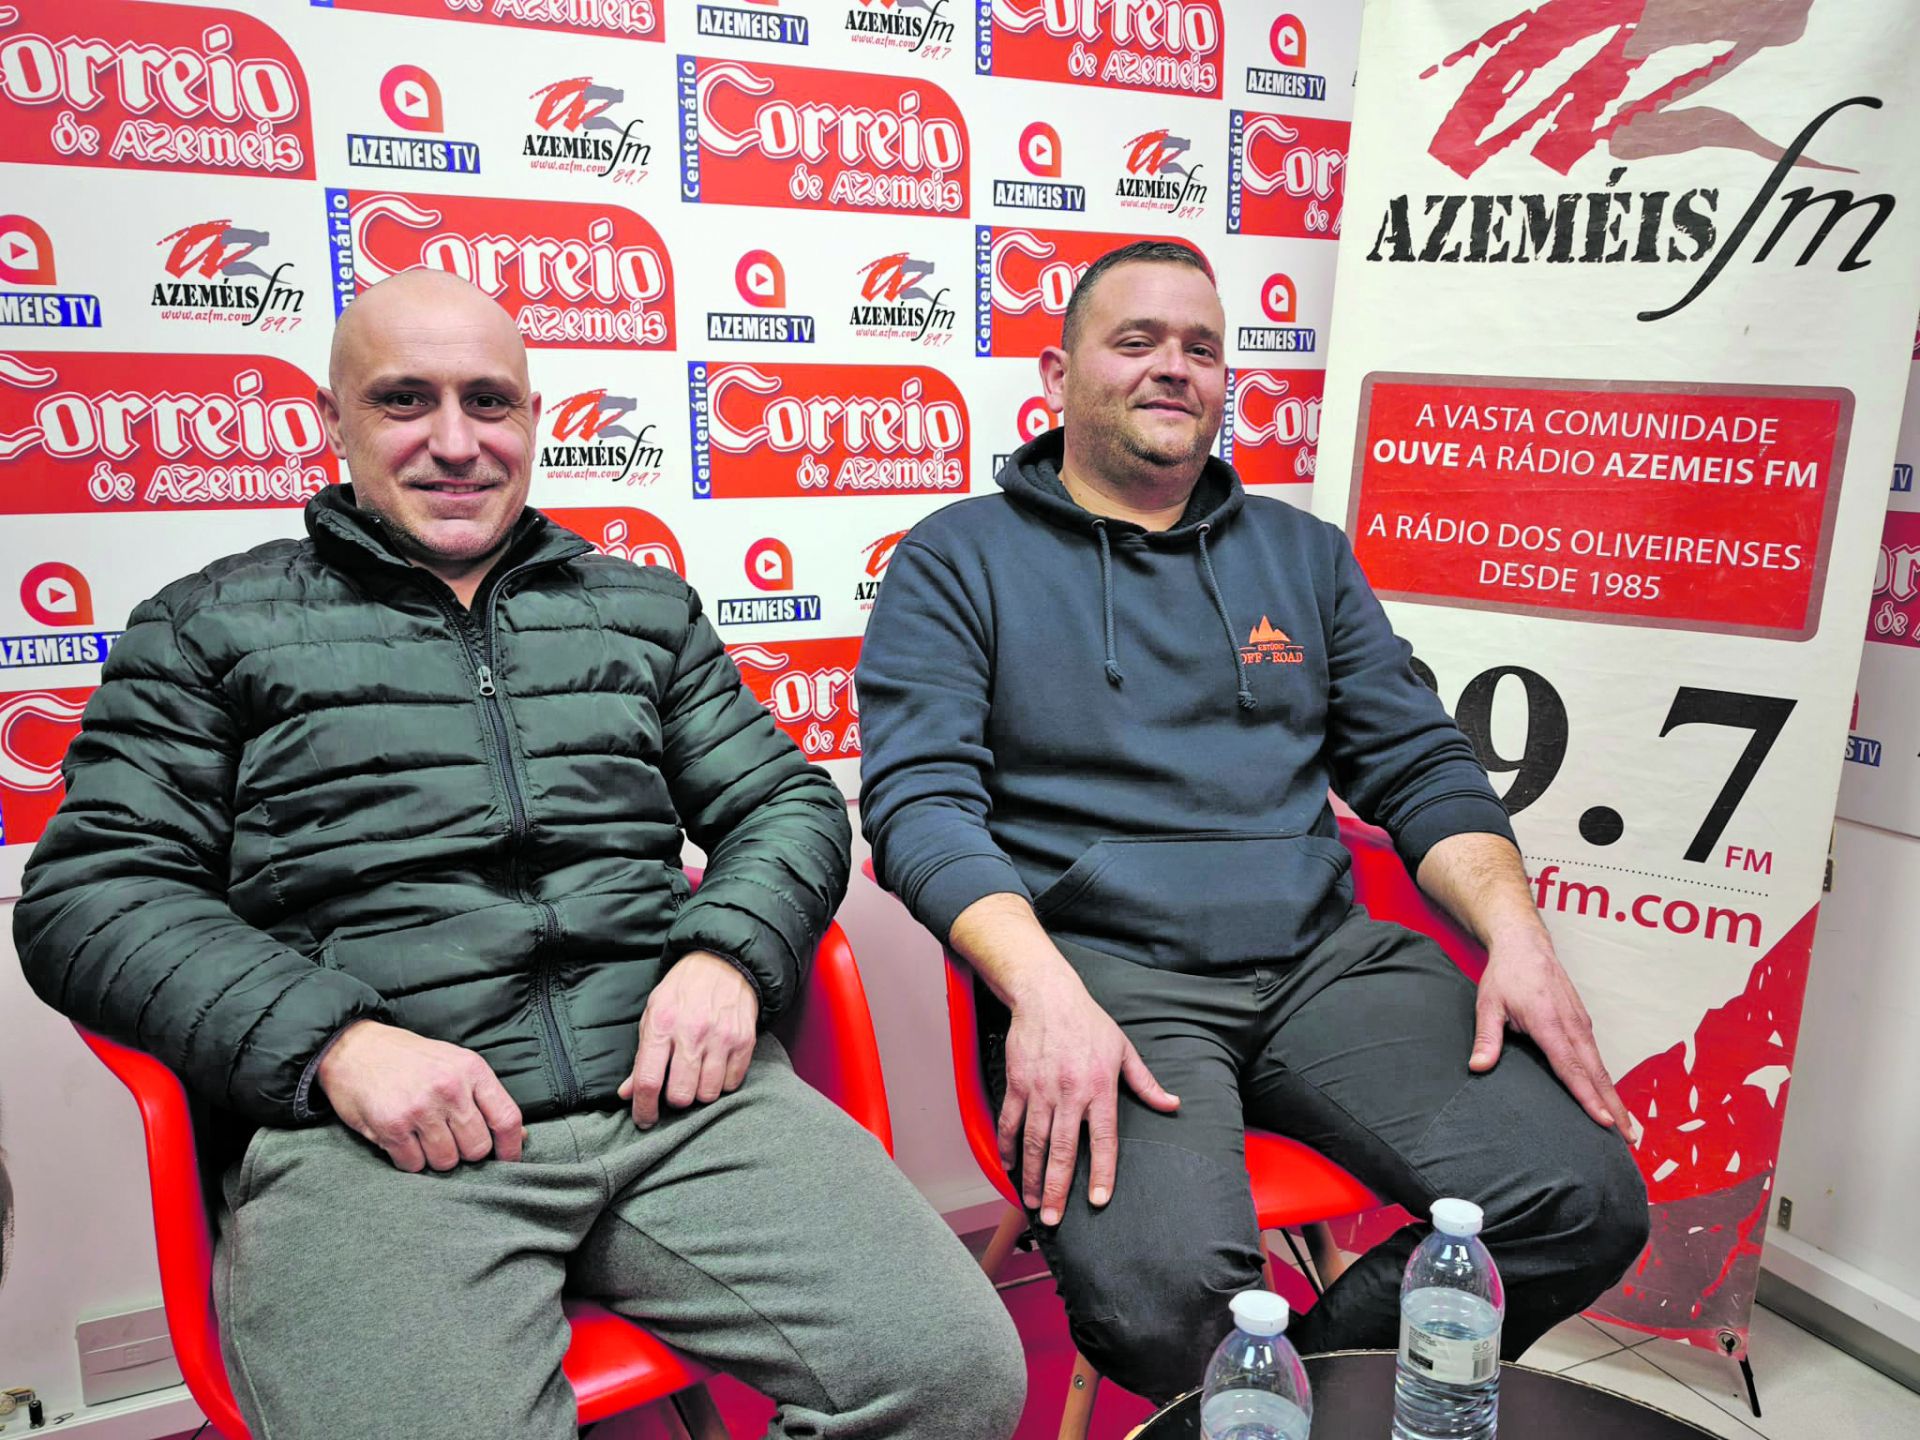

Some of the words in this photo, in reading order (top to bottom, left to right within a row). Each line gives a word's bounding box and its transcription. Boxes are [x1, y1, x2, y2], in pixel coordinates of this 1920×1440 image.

[700, 11, 781, 41] AZEMÉIS
[783, 18, 807, 43] TV
[845, 8, 922, 37] AZEMÉIS
[0, 6, 298, 123] orreio
[1068, 42, 1097, 77] de
[1248, 71, 1305, 97] AZEMÉIS
[1308, 77, 1324, 99] TV
[51, 111, 100, 155] de
[679, 60, 700, 198] Centenário
[696, 62, 963, 172] Correio
[351, 137, 448, 171] AZEMÉIS
[450, 144, 478, 172] TV
[522, 132, 613, 160] AZEMÉIS
[790, 163, 823, 200] de
[1115, 173, 1180, 199] AZEMÉIS
[1228, 114, 1244, 230] Centenário
[995, 182, 1062, 209] AZEMÉIS
[1064, 188, 1083, 210] TV
[1304, 200, 1329, 232] de
[1366, 166, 1718, 264] AZEMÉIS
[151, 278, 260, 308] AZEMÉIS
[977, 229, 991, 353] Centenário
[65, 297, 97, 326] TV
[709, 315, 788, 341] AZEMÉIS
[790, 318, 812, 341] TV
[849, 301, 924, 327] AZEMÉIS
[1239, 329, 1296, 350] AZEMÉIS
[1297, 330, 1314, 350] TV
[707, 364, 963, 453] Correio
[1415, 403, 1435, 428] A
[1443, 404, 1535, 433] VASTA
[1545, 408, 1778, 445] COMUNIDADE
[690, 366, 711, 494] Centenário
[539, 440, 627, 467] AZEMÉIS
[1372, 439, 1459, 468] OUVE
[1467, 445, 1487, 469] A
[1496, 442, 1595, 476] RÁDIO
[1602, 452, 1754, 486] AZEMEIS
[1764, 459, 1818, 488] FM
[89, 461, 135, 502] de
[797, 454, 829, 488] de
[1367, 513, 1387, 538] A
[1395, 512, 1490, 546] RÁDIO
[1497, 522, 1561, 553] DOS
[1570, 529, 1802, 570] OLIVEIRENSES
[1478, 560, 1576, 594] DESDE
[1589, 571, 1662, 600] 1985
[720, 599, 795, 624] AZEMÉIS
[797, 597, 818, 620] TV
[1875, 601, 1908, 636] de
[1272, 651, 1304, 664] ROAD
[803, 722, 834, 754] de
[1858, 740, 1879, 764] TV
[1410, 656, 1798, 863] 9.7
[1724, 845, 1773, 875] FM
